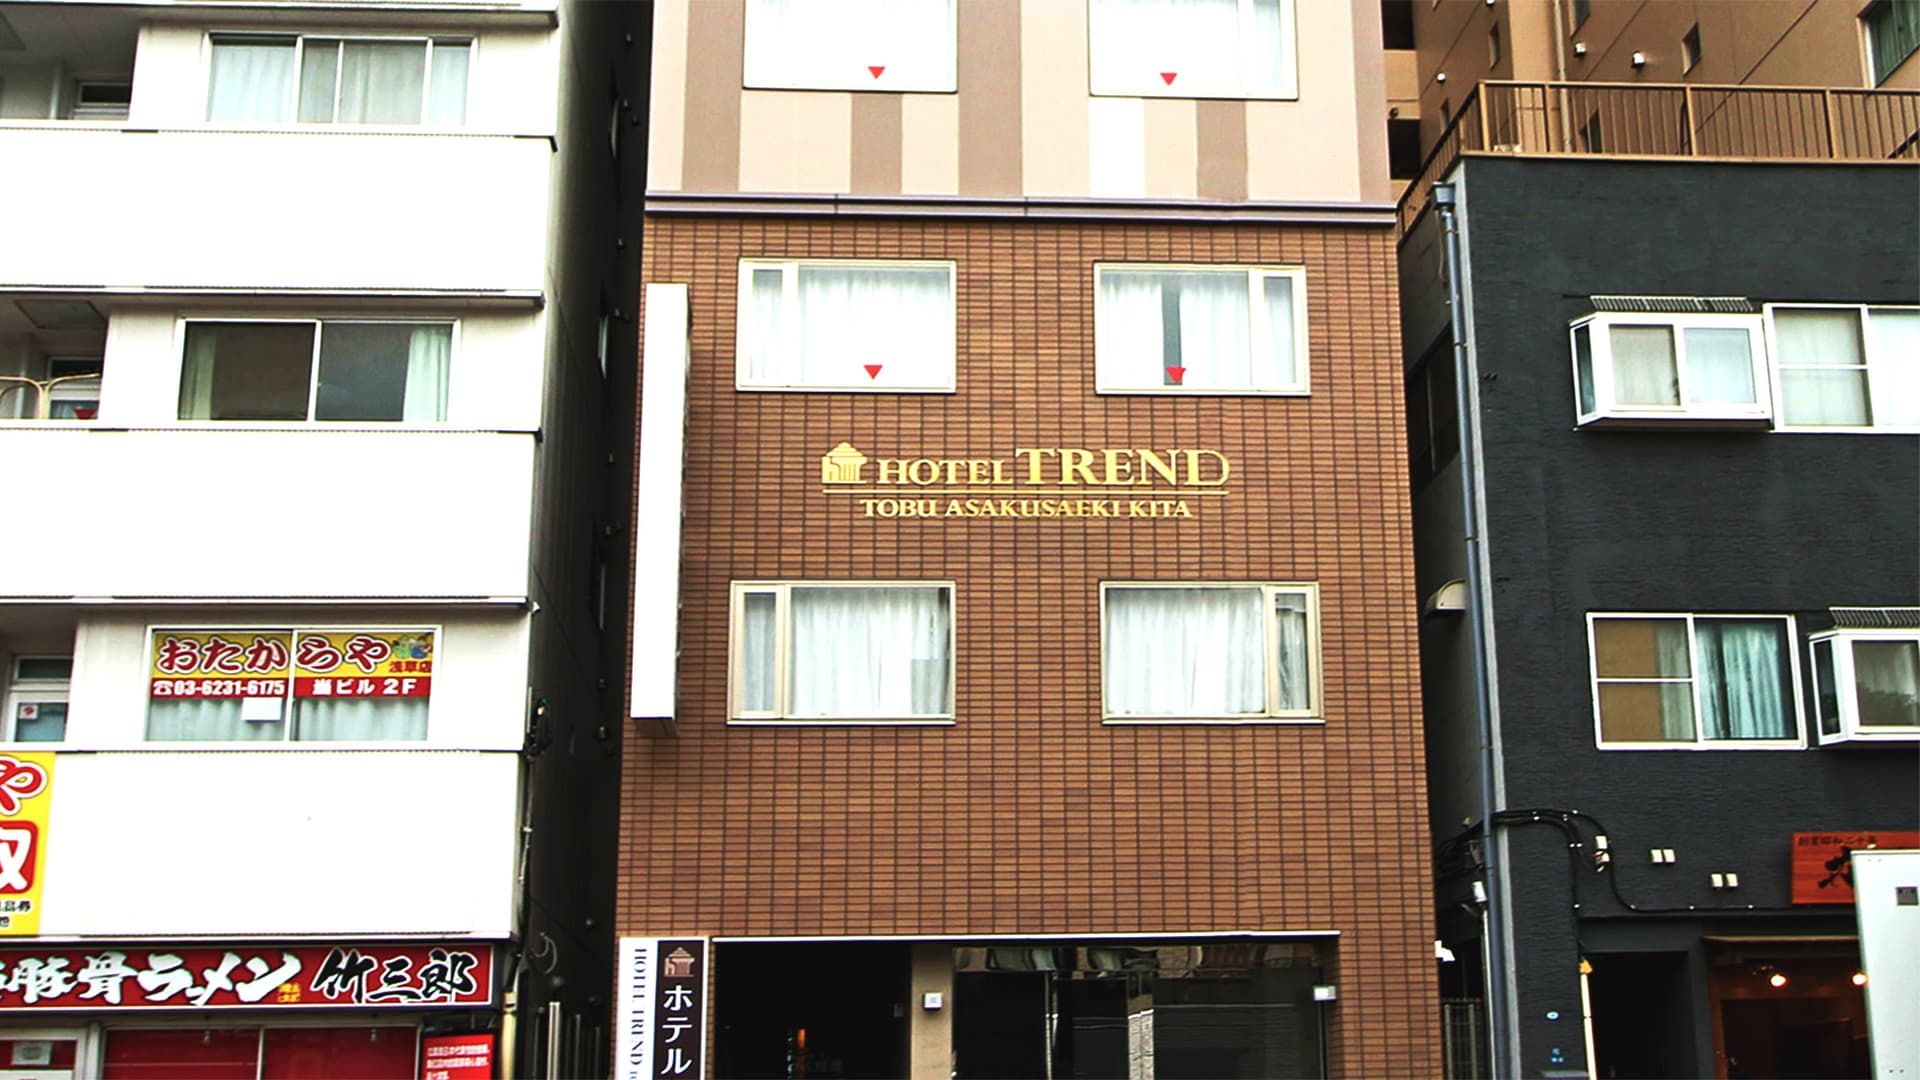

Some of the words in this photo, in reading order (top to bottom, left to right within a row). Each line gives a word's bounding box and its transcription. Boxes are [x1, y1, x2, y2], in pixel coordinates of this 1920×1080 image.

[876, 458, 1014, 486] HOTEL
[1015, 447, 1231, 487] TREND
[860, 499, 937, 518] TOBU
[944, 499, 1121, 518] ASAKUSAEKI
[1129, 500, 1193, 518] KITA
[157, 636, 391, 674] おたからや
[173, 679, 286, 696] 03-6231-6175
[382, 678, 417, 695] 2F
[0, 951, 302, 1005] 豚骨ラーメン
[310, 946, 478, 1004] 竹三郎
[632, 948, 647, 1004] HOTEL
[630, 1006, 645, 1066] TREND
[660, 984, 694, 1076] ホテル
